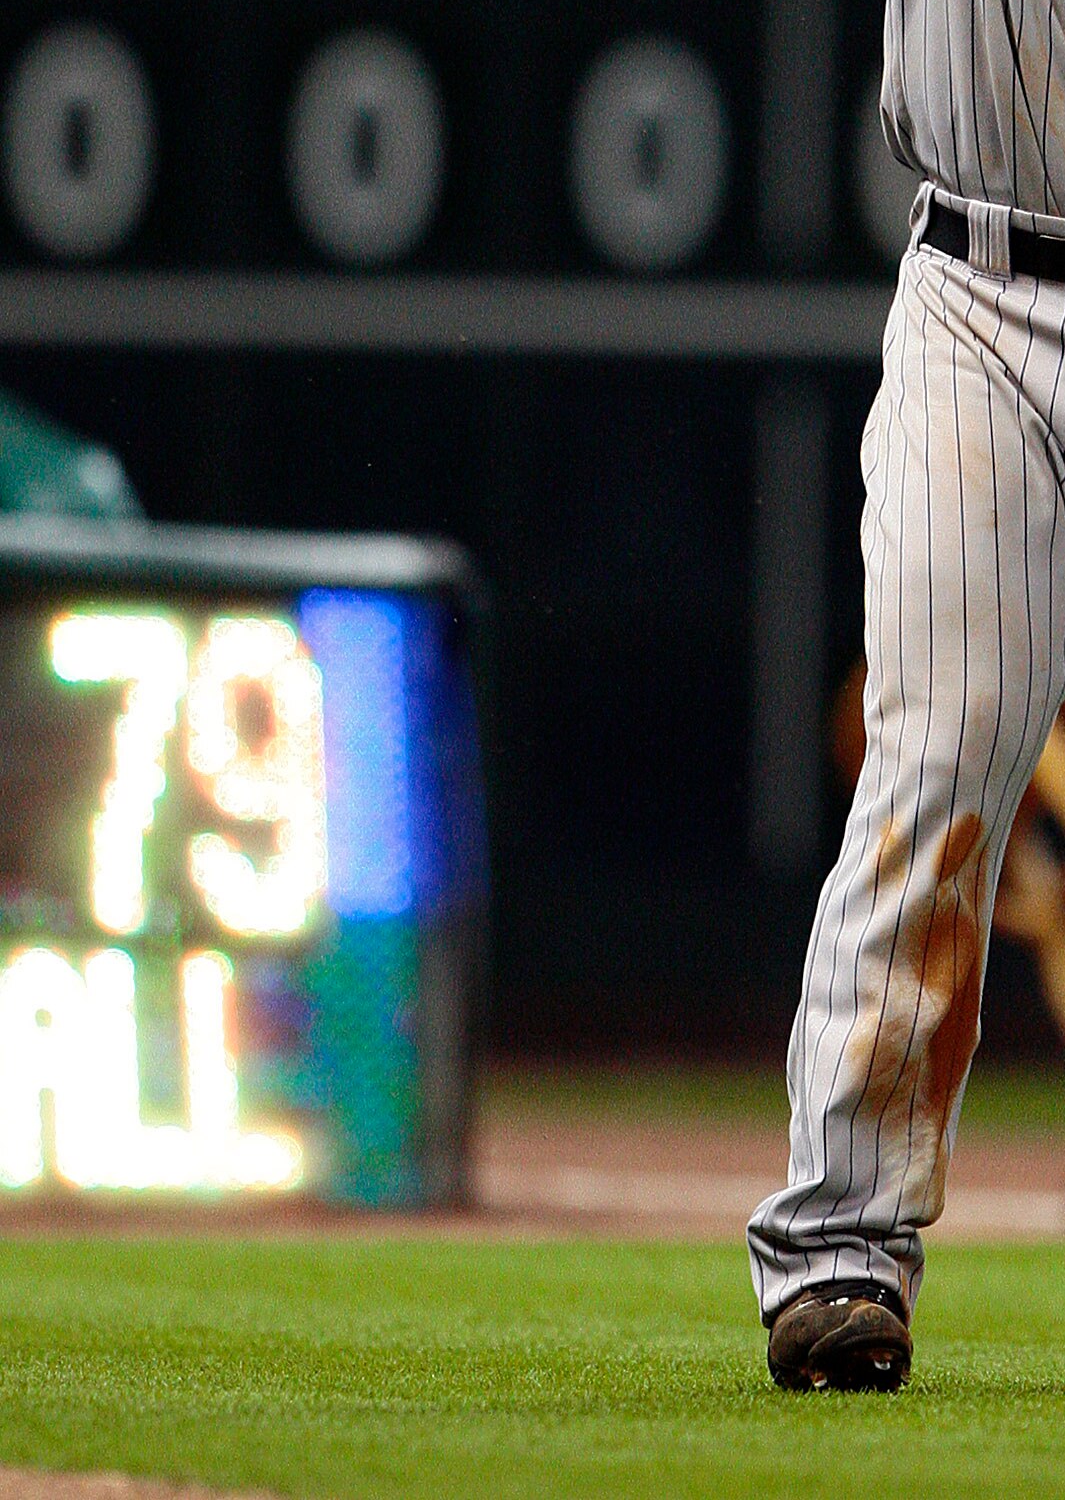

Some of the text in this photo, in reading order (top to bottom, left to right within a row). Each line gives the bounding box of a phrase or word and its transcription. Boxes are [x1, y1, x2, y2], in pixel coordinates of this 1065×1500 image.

[7, 31, 150, 252] 0
[293, 36, 439, 259] 0
[575, 43, 723, 266] 0
[48, 608, 328, 938] 79
